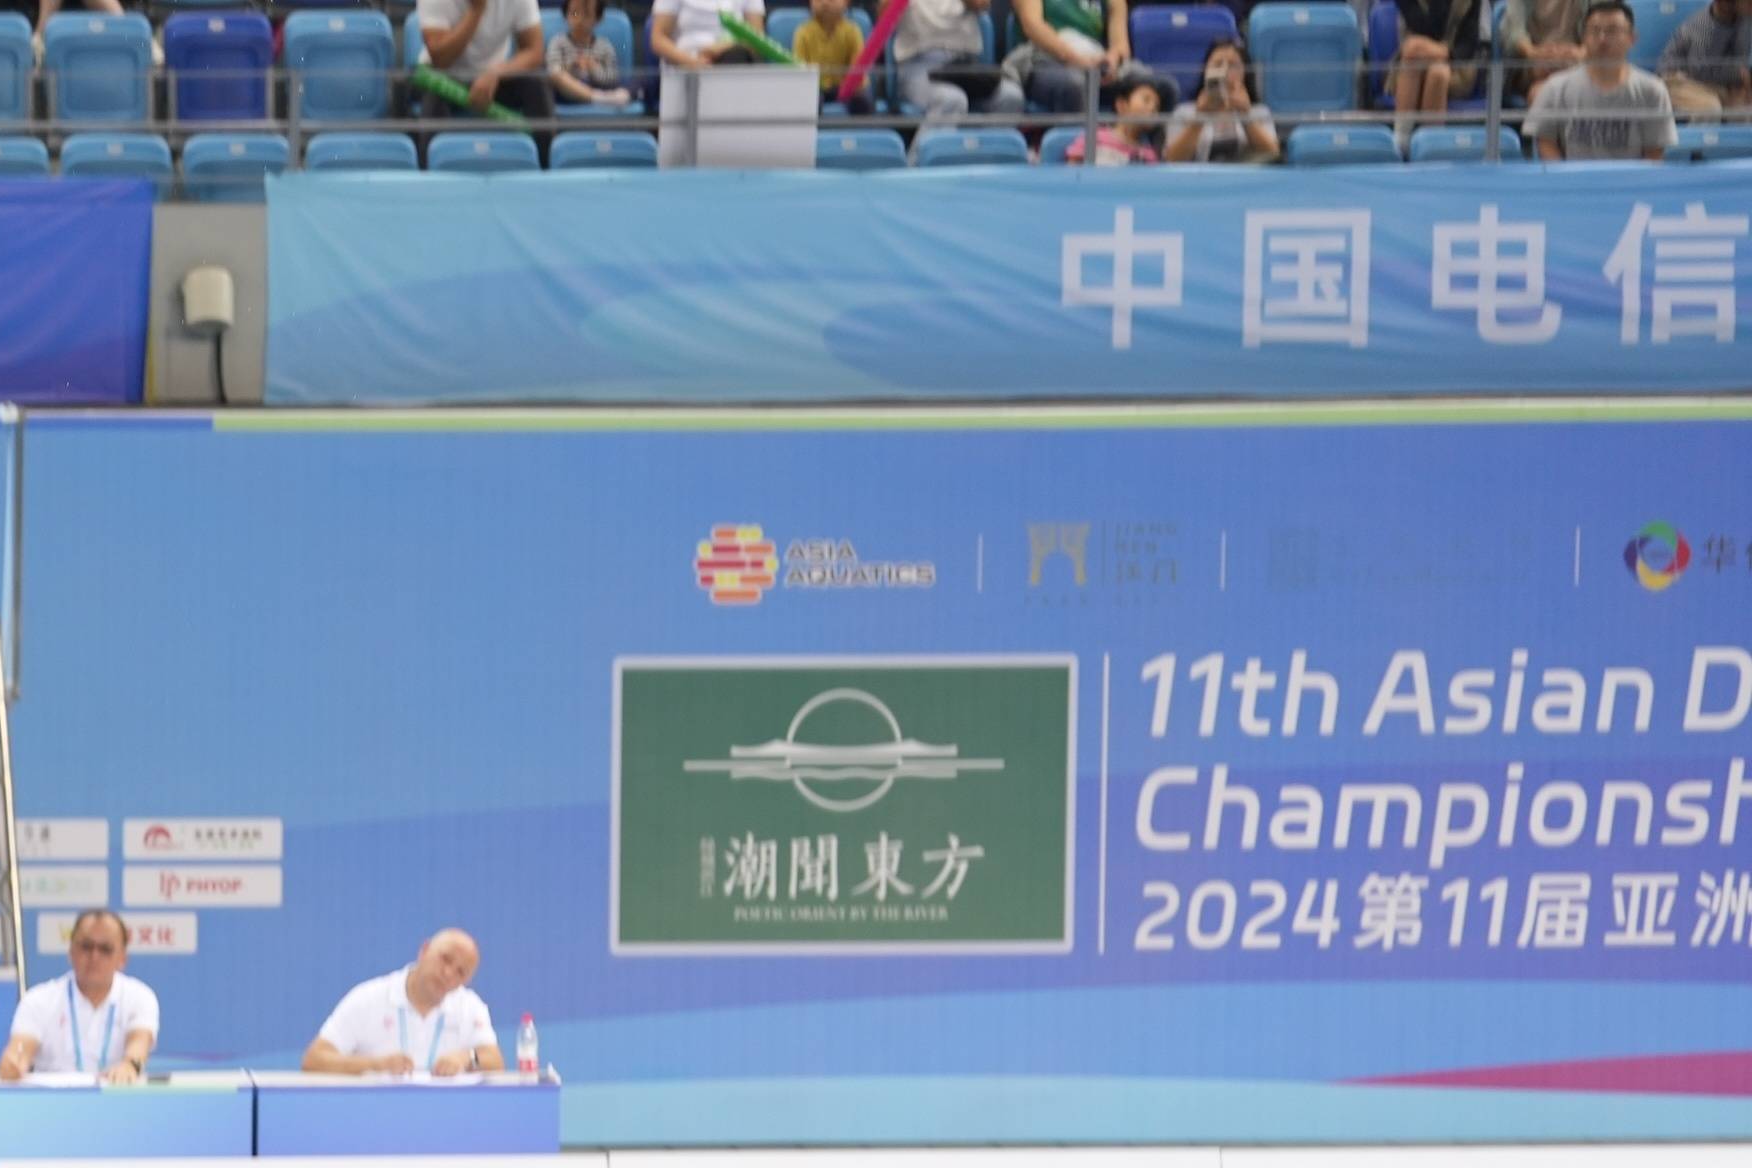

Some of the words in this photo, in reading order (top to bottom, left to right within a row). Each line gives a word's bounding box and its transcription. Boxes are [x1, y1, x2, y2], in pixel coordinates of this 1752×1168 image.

[1061, 202, 1751, 349] 中国电信
[784, 563, 936, 588] AQUATICS
[785, 539, 856, 562] ASIA
[1141, 649, 1341, 738] 11th
[1363, 647, 1654, 736] Asian
